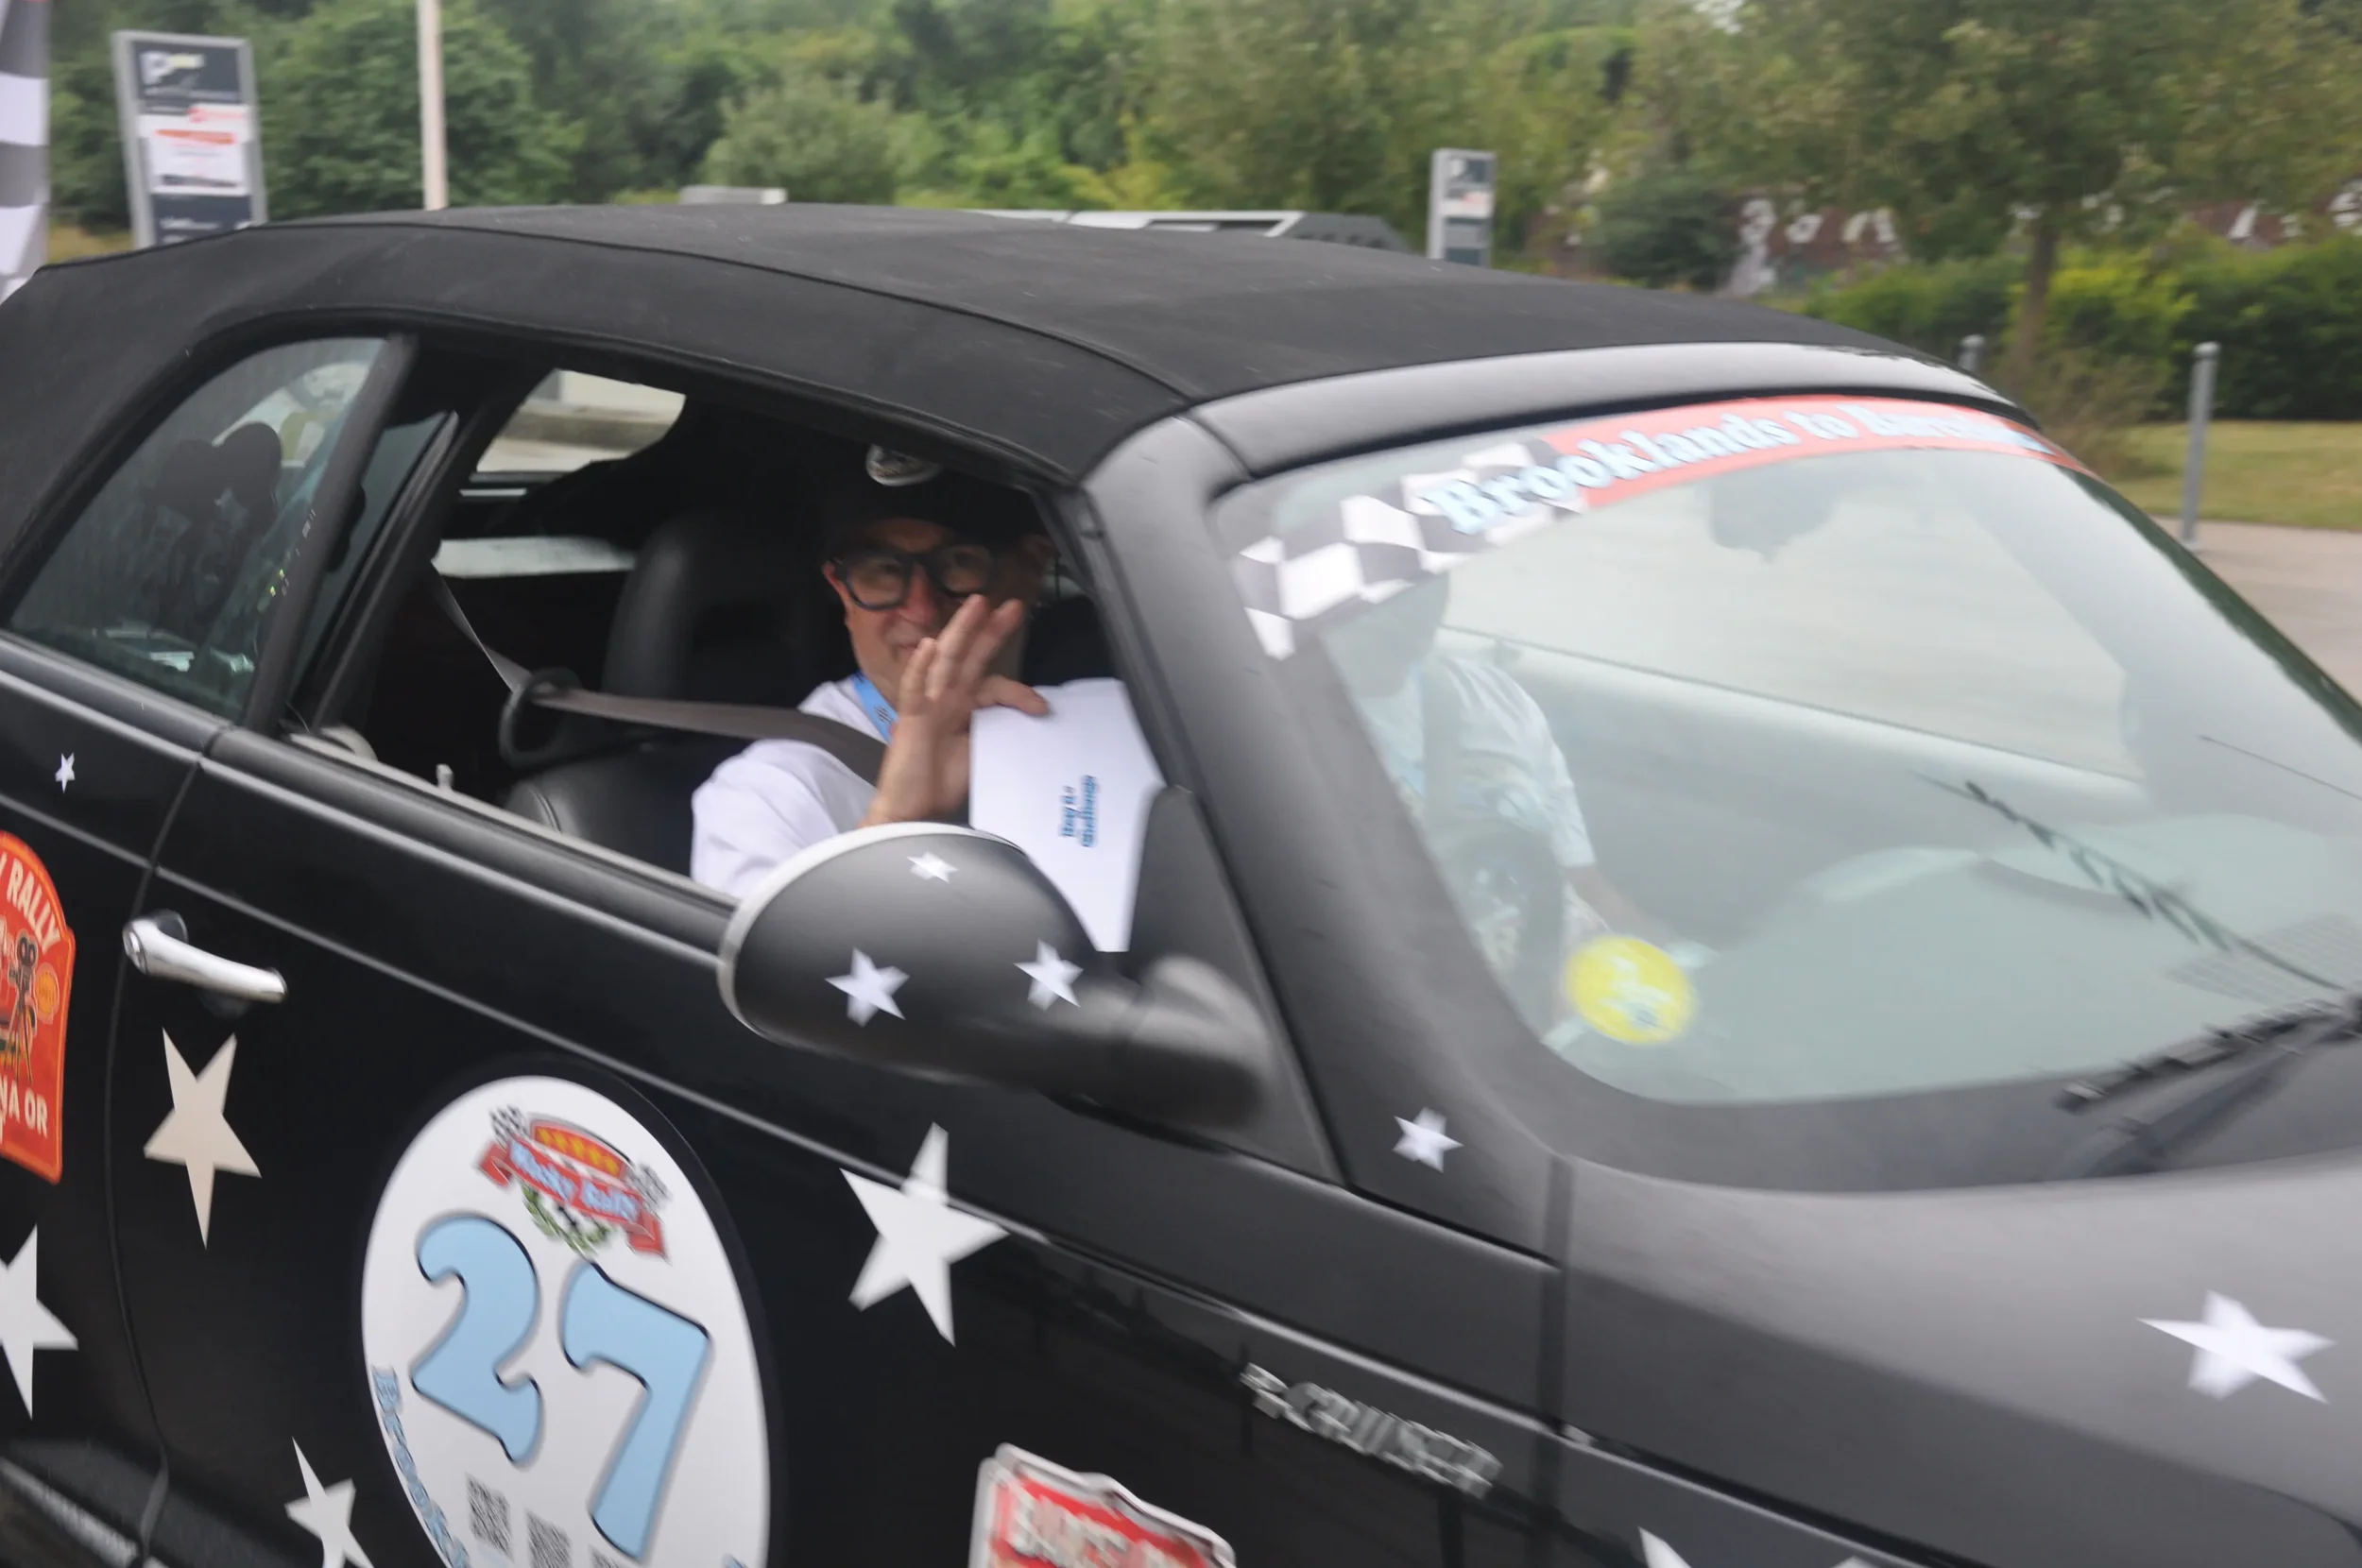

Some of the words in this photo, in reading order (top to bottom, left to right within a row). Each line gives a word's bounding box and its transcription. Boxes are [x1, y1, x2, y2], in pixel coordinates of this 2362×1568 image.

[1418, 412, 1802, 536] Brooklands
[1782, 409, 1860, 441] to
[6, 857, 61, 954] RALLY
[24, 1086, 48, 1140] OR
[410, 1213, 711, 1562] 27
